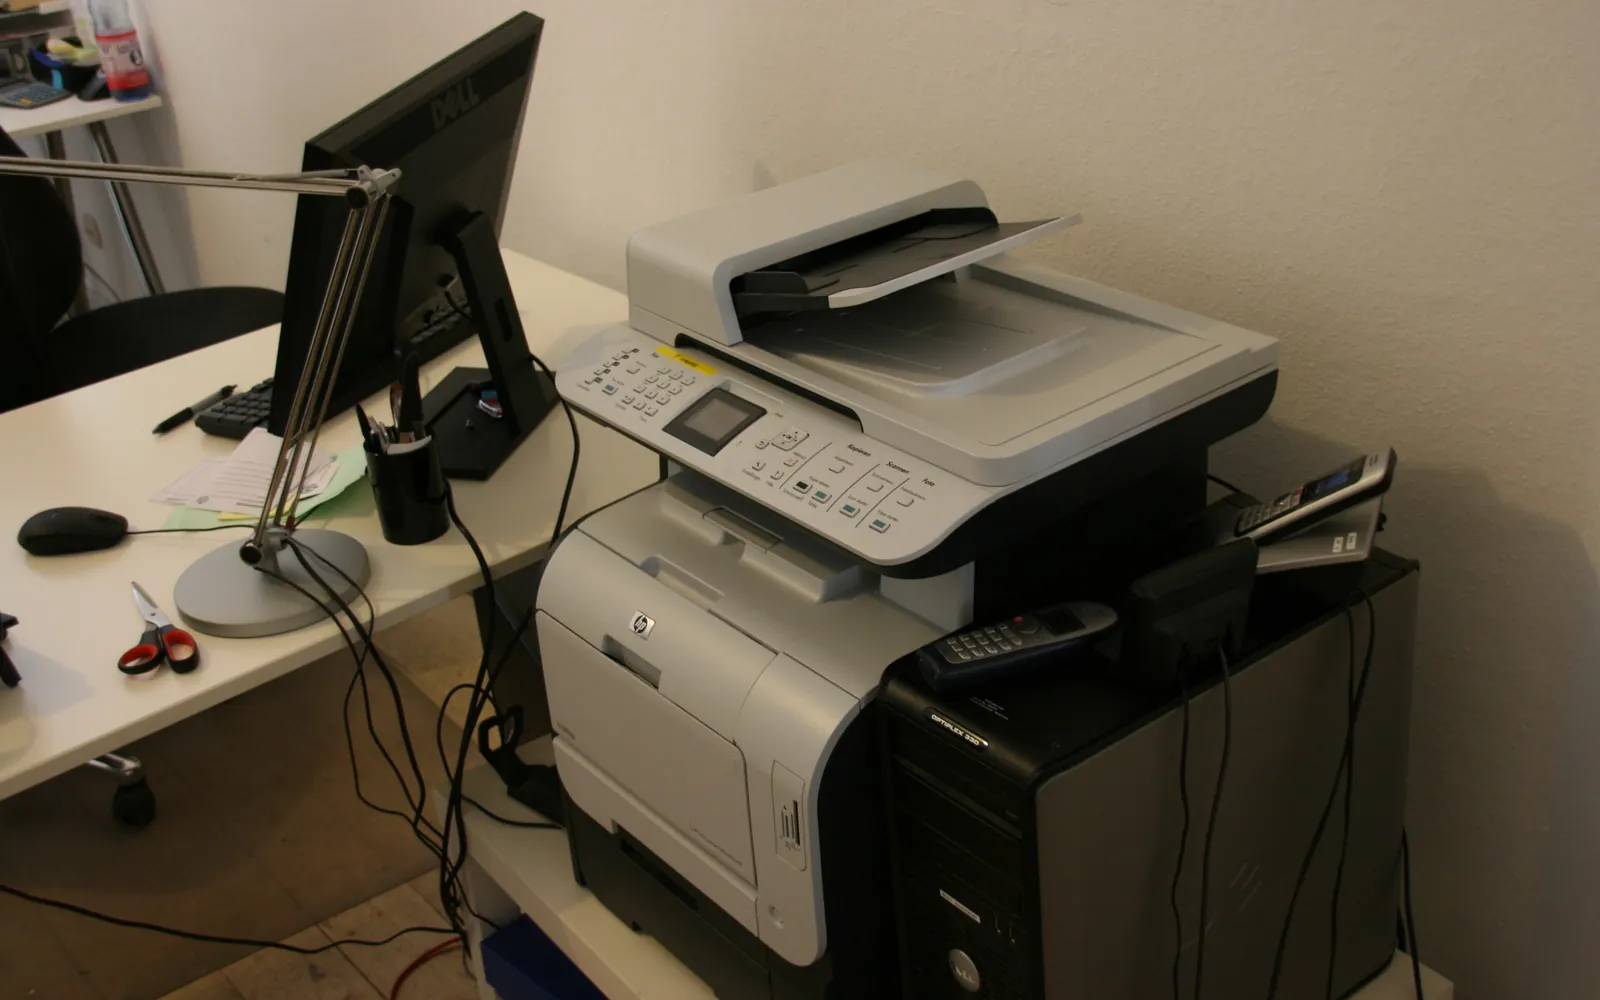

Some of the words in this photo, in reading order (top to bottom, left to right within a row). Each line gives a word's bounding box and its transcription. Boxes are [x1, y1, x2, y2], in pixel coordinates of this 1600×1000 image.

[430, 78, 480, 129] DELL
[931, 714, 963, 736] OPTIPLEX
[964, 732, 980, 746] 330
